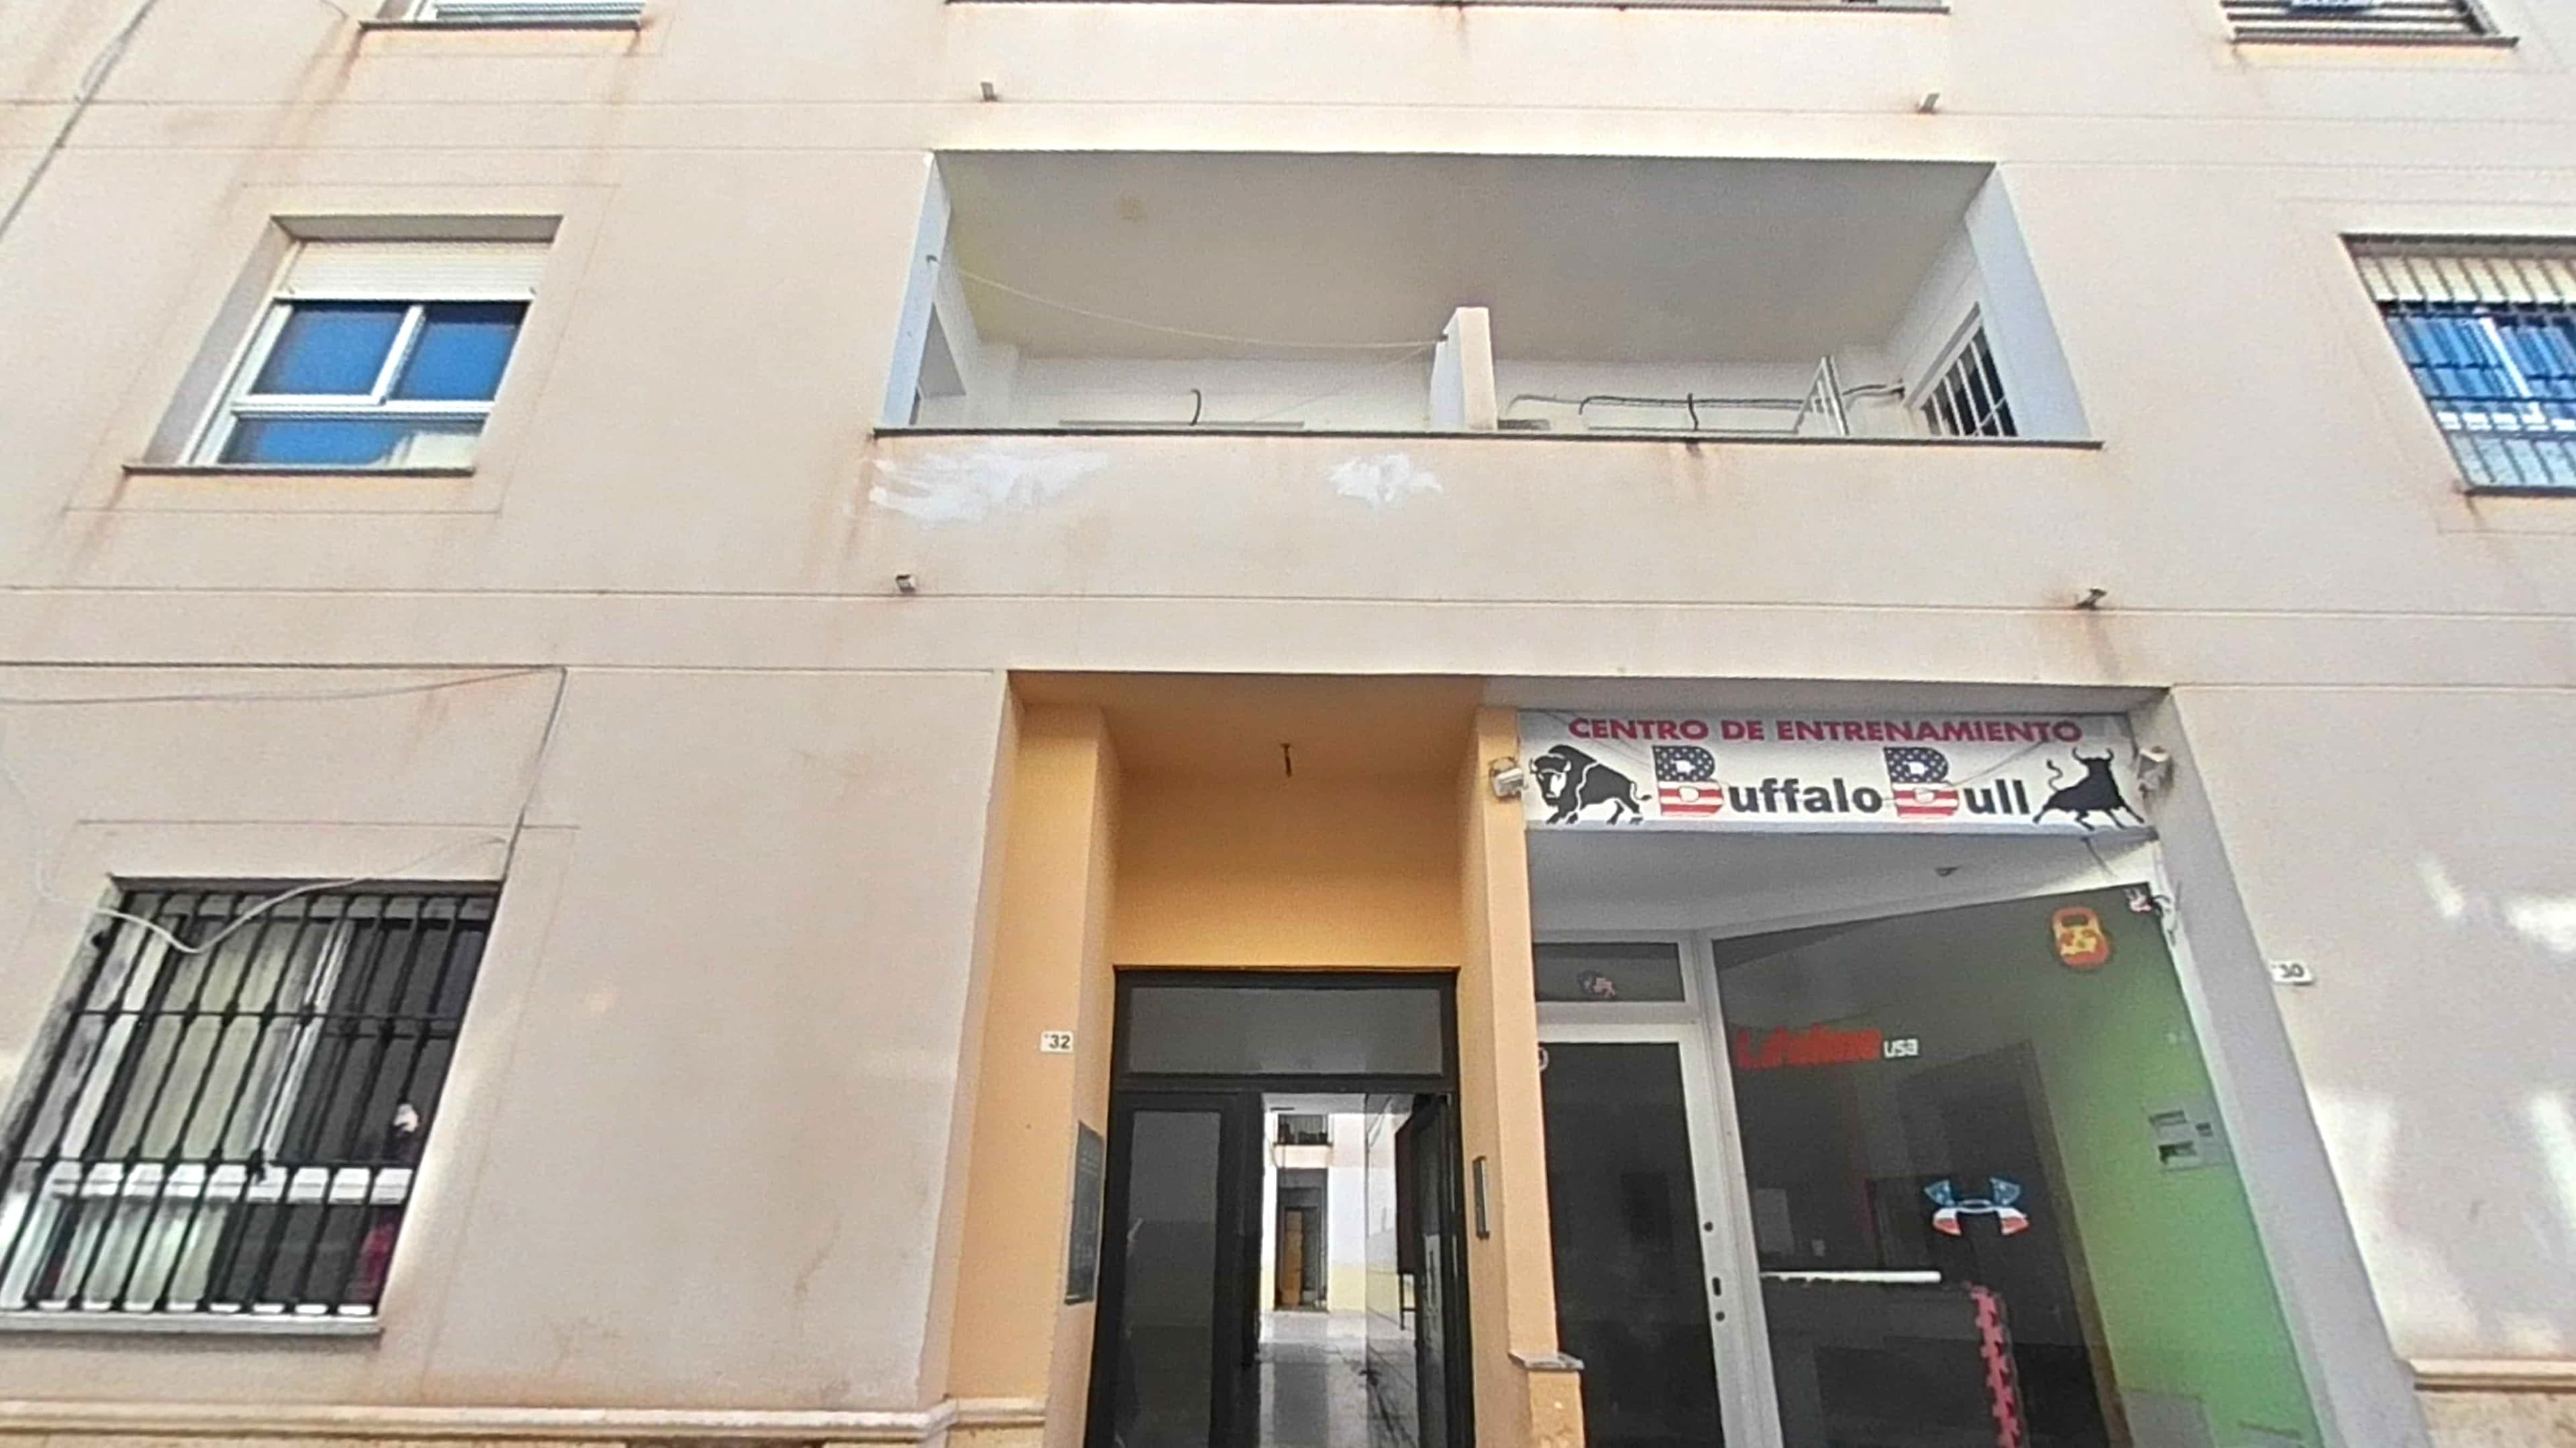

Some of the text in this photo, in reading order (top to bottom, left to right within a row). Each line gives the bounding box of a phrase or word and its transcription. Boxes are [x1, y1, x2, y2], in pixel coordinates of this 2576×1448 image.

[1568, 718, 2083, 743] CENTRO DE ENTRENAMIENTO
[1652, 745, 2031, 819] Buffalo Bull
